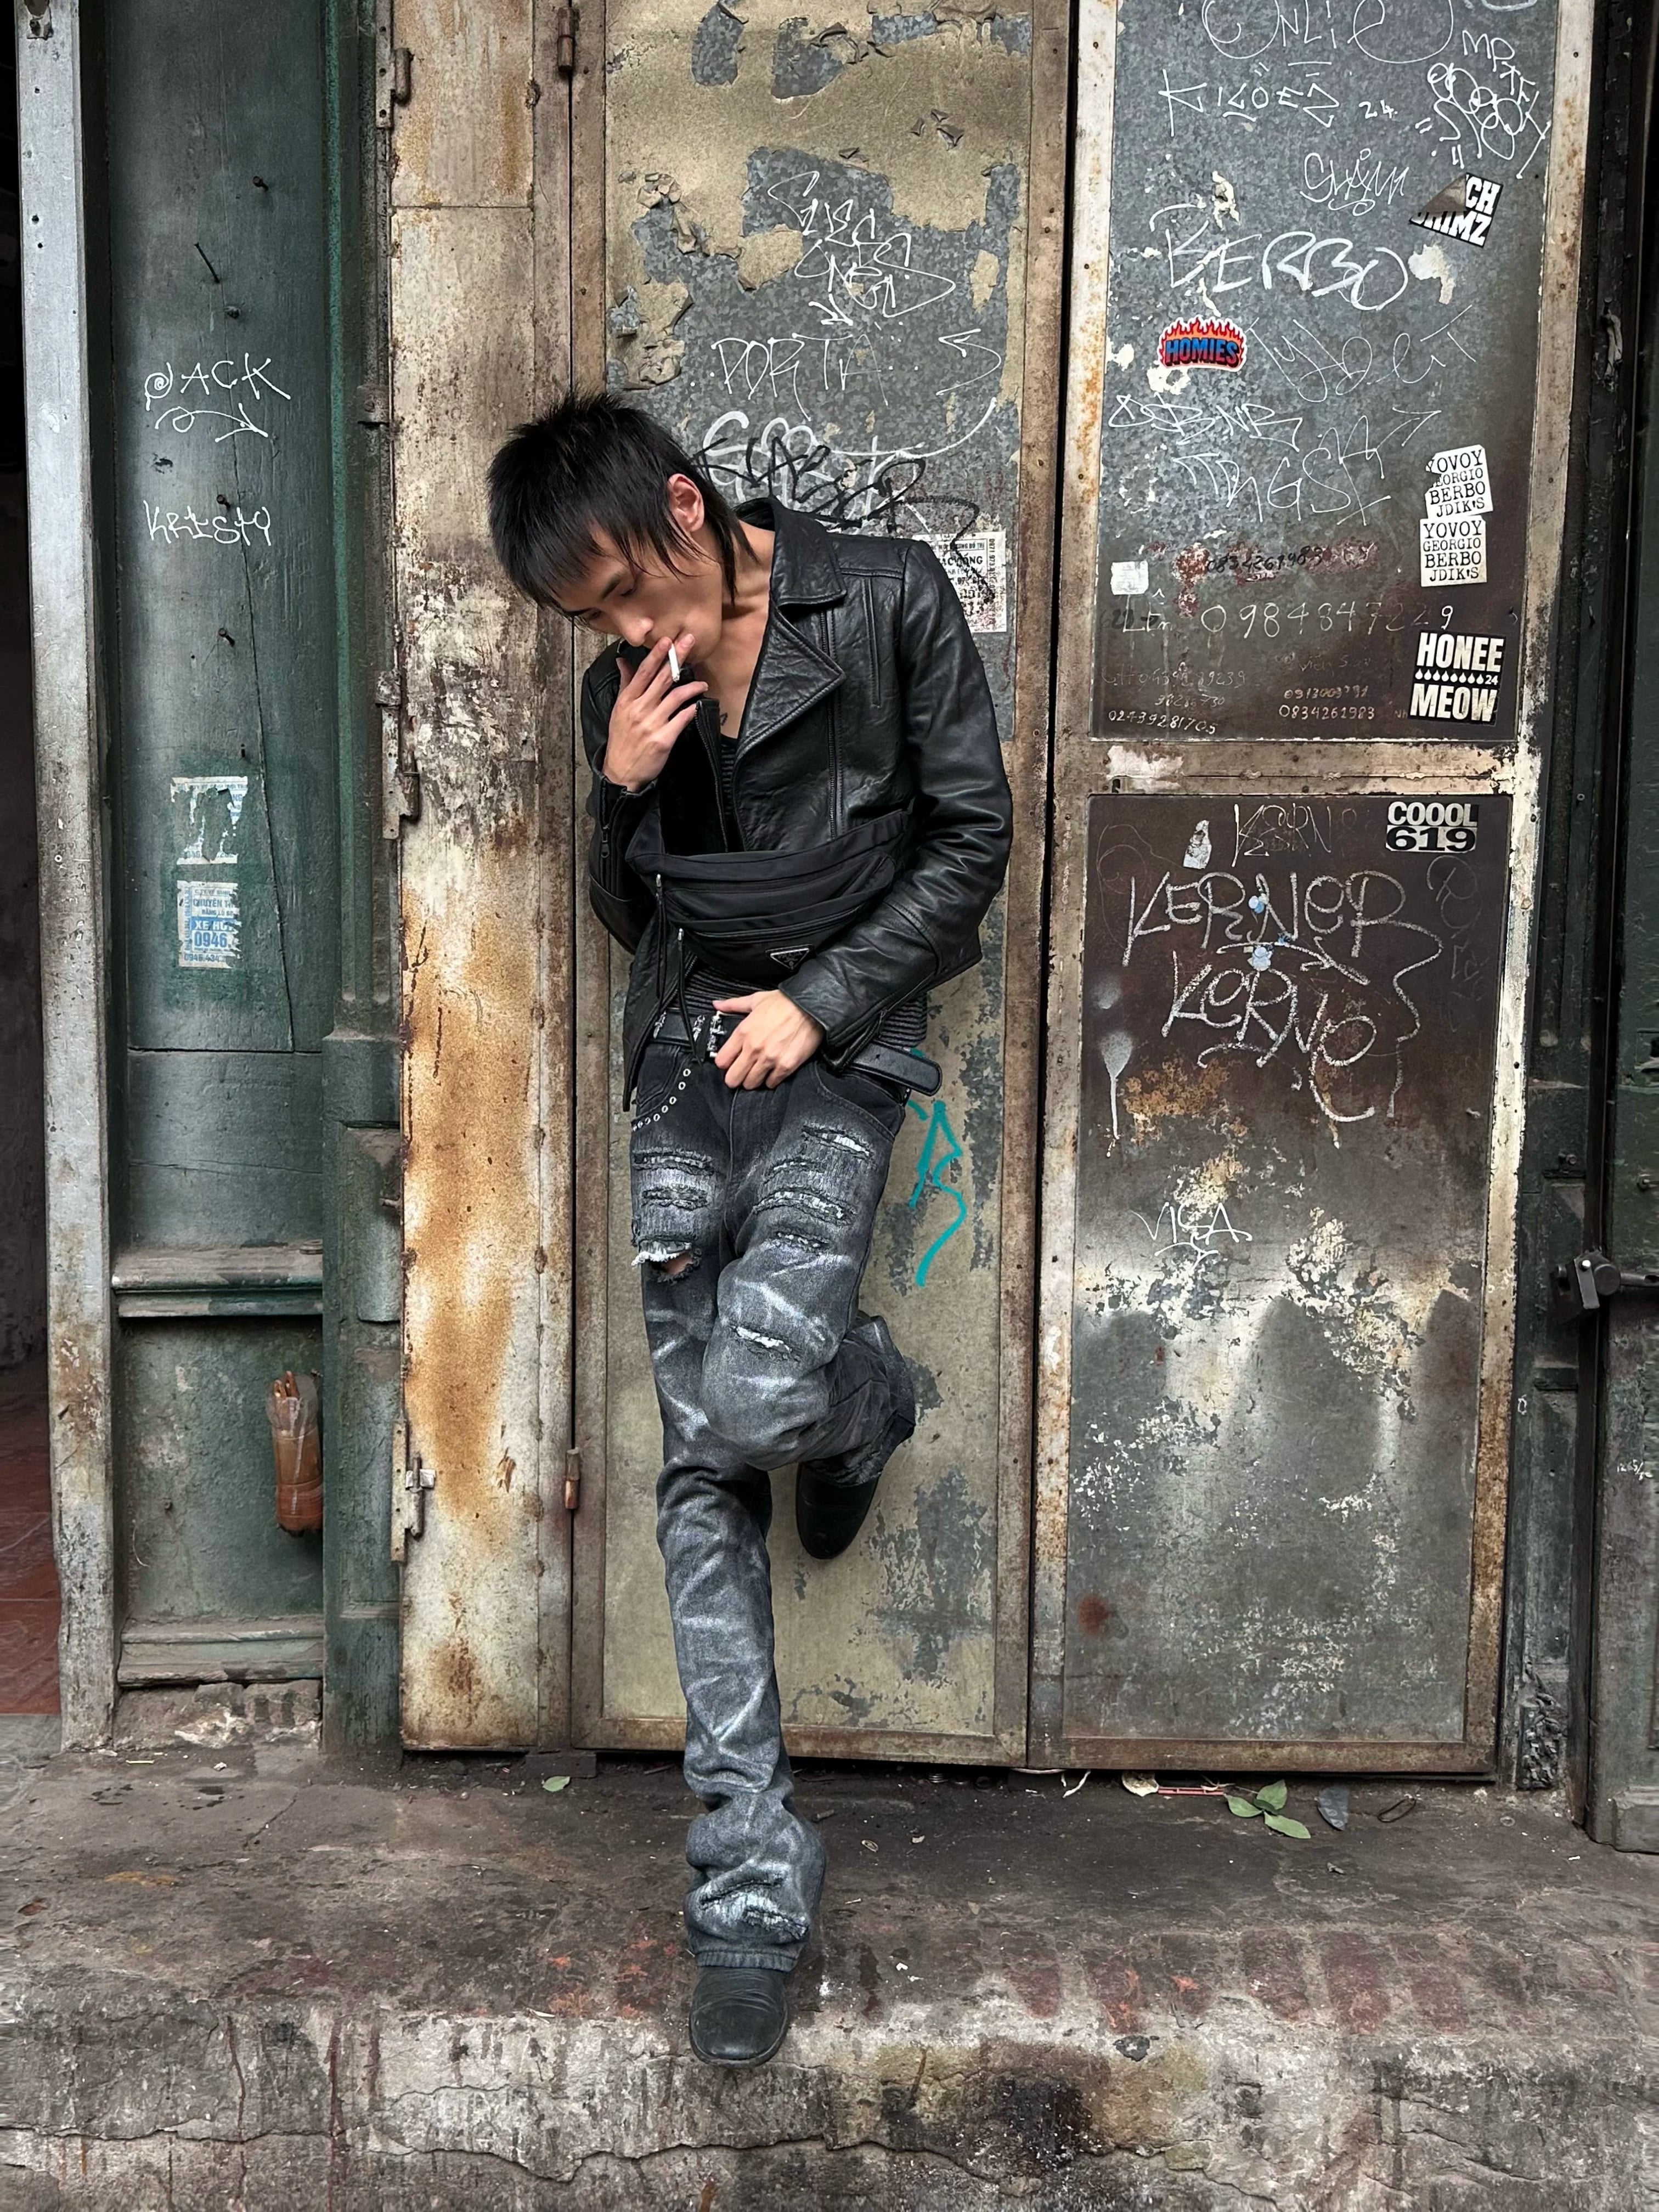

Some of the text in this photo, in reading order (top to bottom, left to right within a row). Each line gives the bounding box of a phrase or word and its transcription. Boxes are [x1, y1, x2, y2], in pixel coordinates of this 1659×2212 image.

[1165, 337, 1240, 368] HOMIES
[1427, 449, 1483, 473] YOVOY
[1433, 467, 1483, 488] EORGIO
[1429, 481, 1486, 505] BERBO
[1436, 497, 1485, 517] JDIK'S
[1424, 520, 1482, 539] YOVOY
[1423, 537, 1481, 552] GEORGIO
[1425, 551, 1481, 568] BERBO
[1429, 567, 1480, 582] JDIK'S
[1416, 631, 1504, 673] HONEE
[1485, 674, 1498, 685] 24
[1279, 704, 1375, 720] 0834261983
[1409, 683, 1498, 722] MEOW
[1387, 801, 1477, 827] COOOL
[1386, 826, 1476, 852] 619
[195, 919, 209, 929] XE
